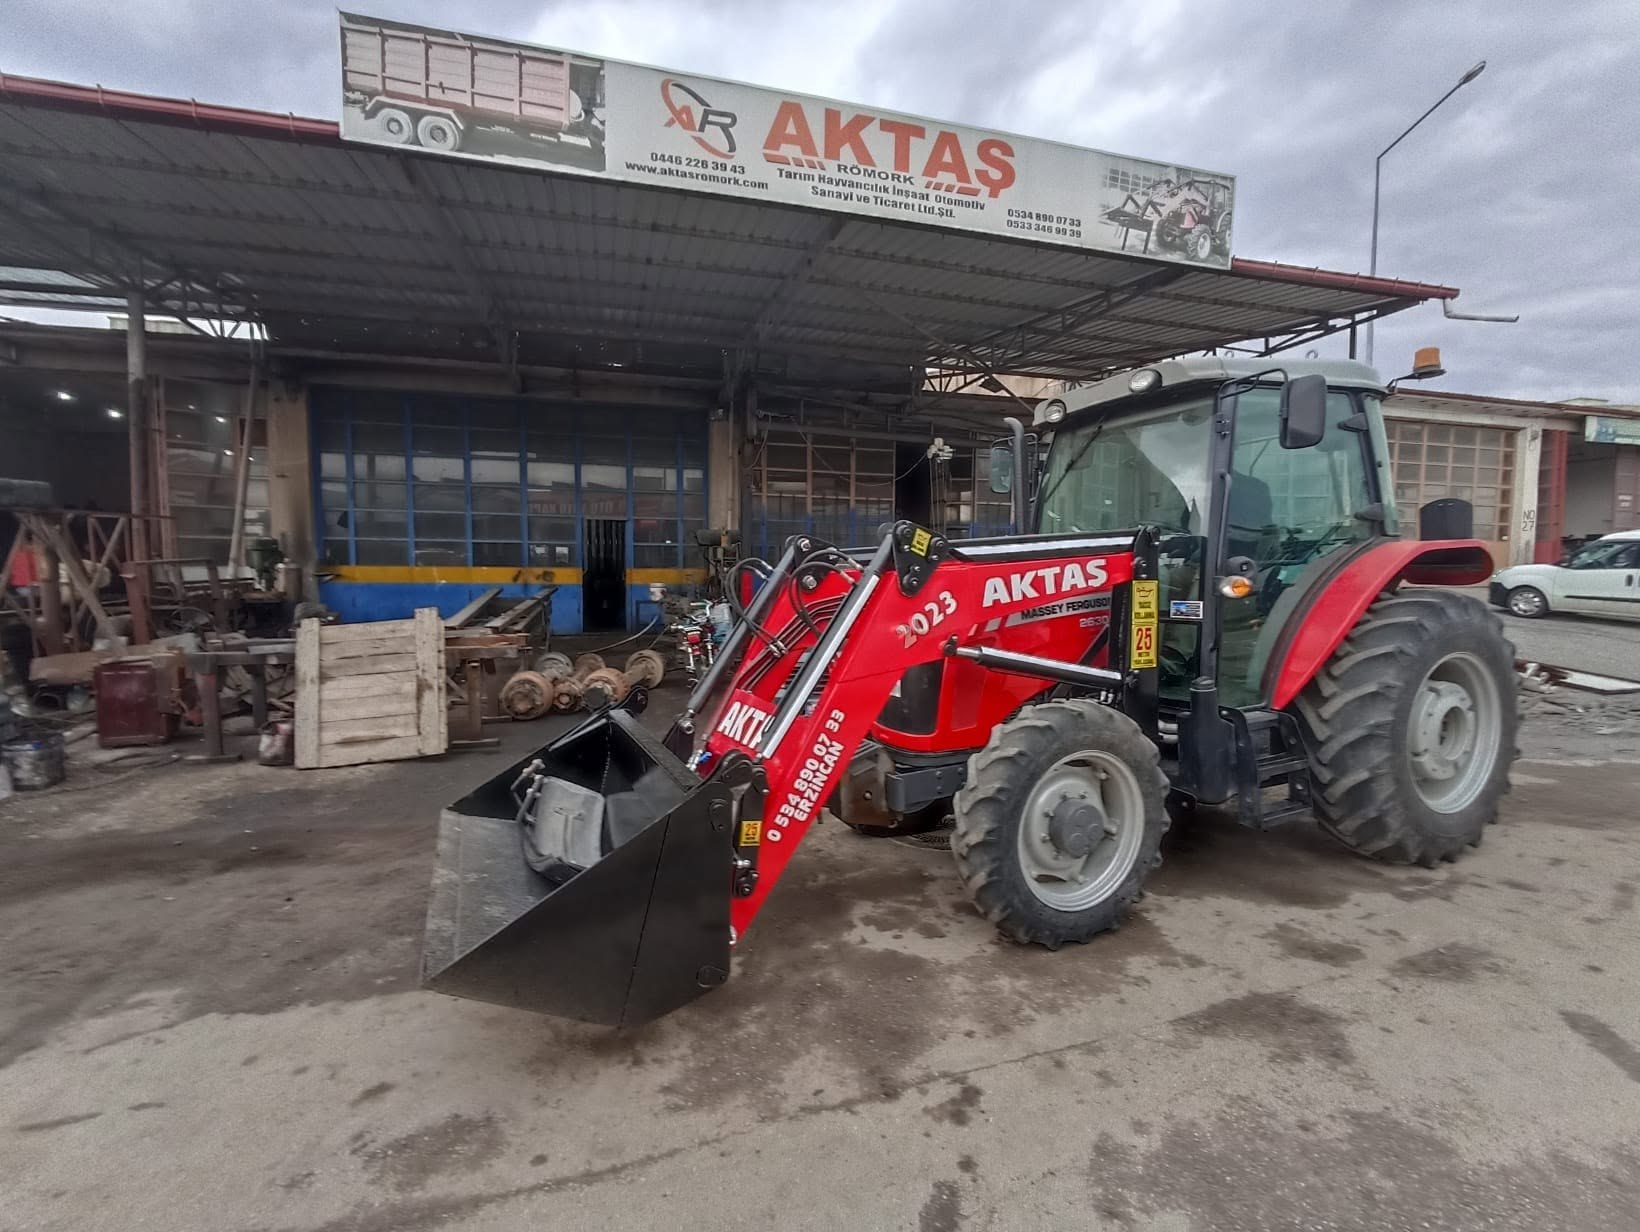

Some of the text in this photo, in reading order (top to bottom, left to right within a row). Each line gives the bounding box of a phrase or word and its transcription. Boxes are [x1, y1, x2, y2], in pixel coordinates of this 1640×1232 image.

[762, 100, 1016, 199] AKTAŞ
[650, 152, 746, 175] 0446 226 39 43
[837, 163, 915, 186] RÖMORK
[624, 161, 769, 190] www.aktasromork.com
[777, 168, 815, 182] Tarım
[934, 193, 986, 211] Otomotiv
[856, 195, 870, 204] ve
[872, 195, 915, 212] Ticaret
[1006, 219, 1032, 230] 0533
[1034, 223, 1053, 234] 346
[1007, 208, 1034, 220] 0534
[1035, 212, 1054, 223] 890
[1521, 520, 1535, 531] 27
[895, 590, 958, 649] 2023
[1021, 603, 1063, 620] MASSEY
[1136, 627, 1152, 651] 25
[766, 709, 845, 842] 0 534 890 07 33
